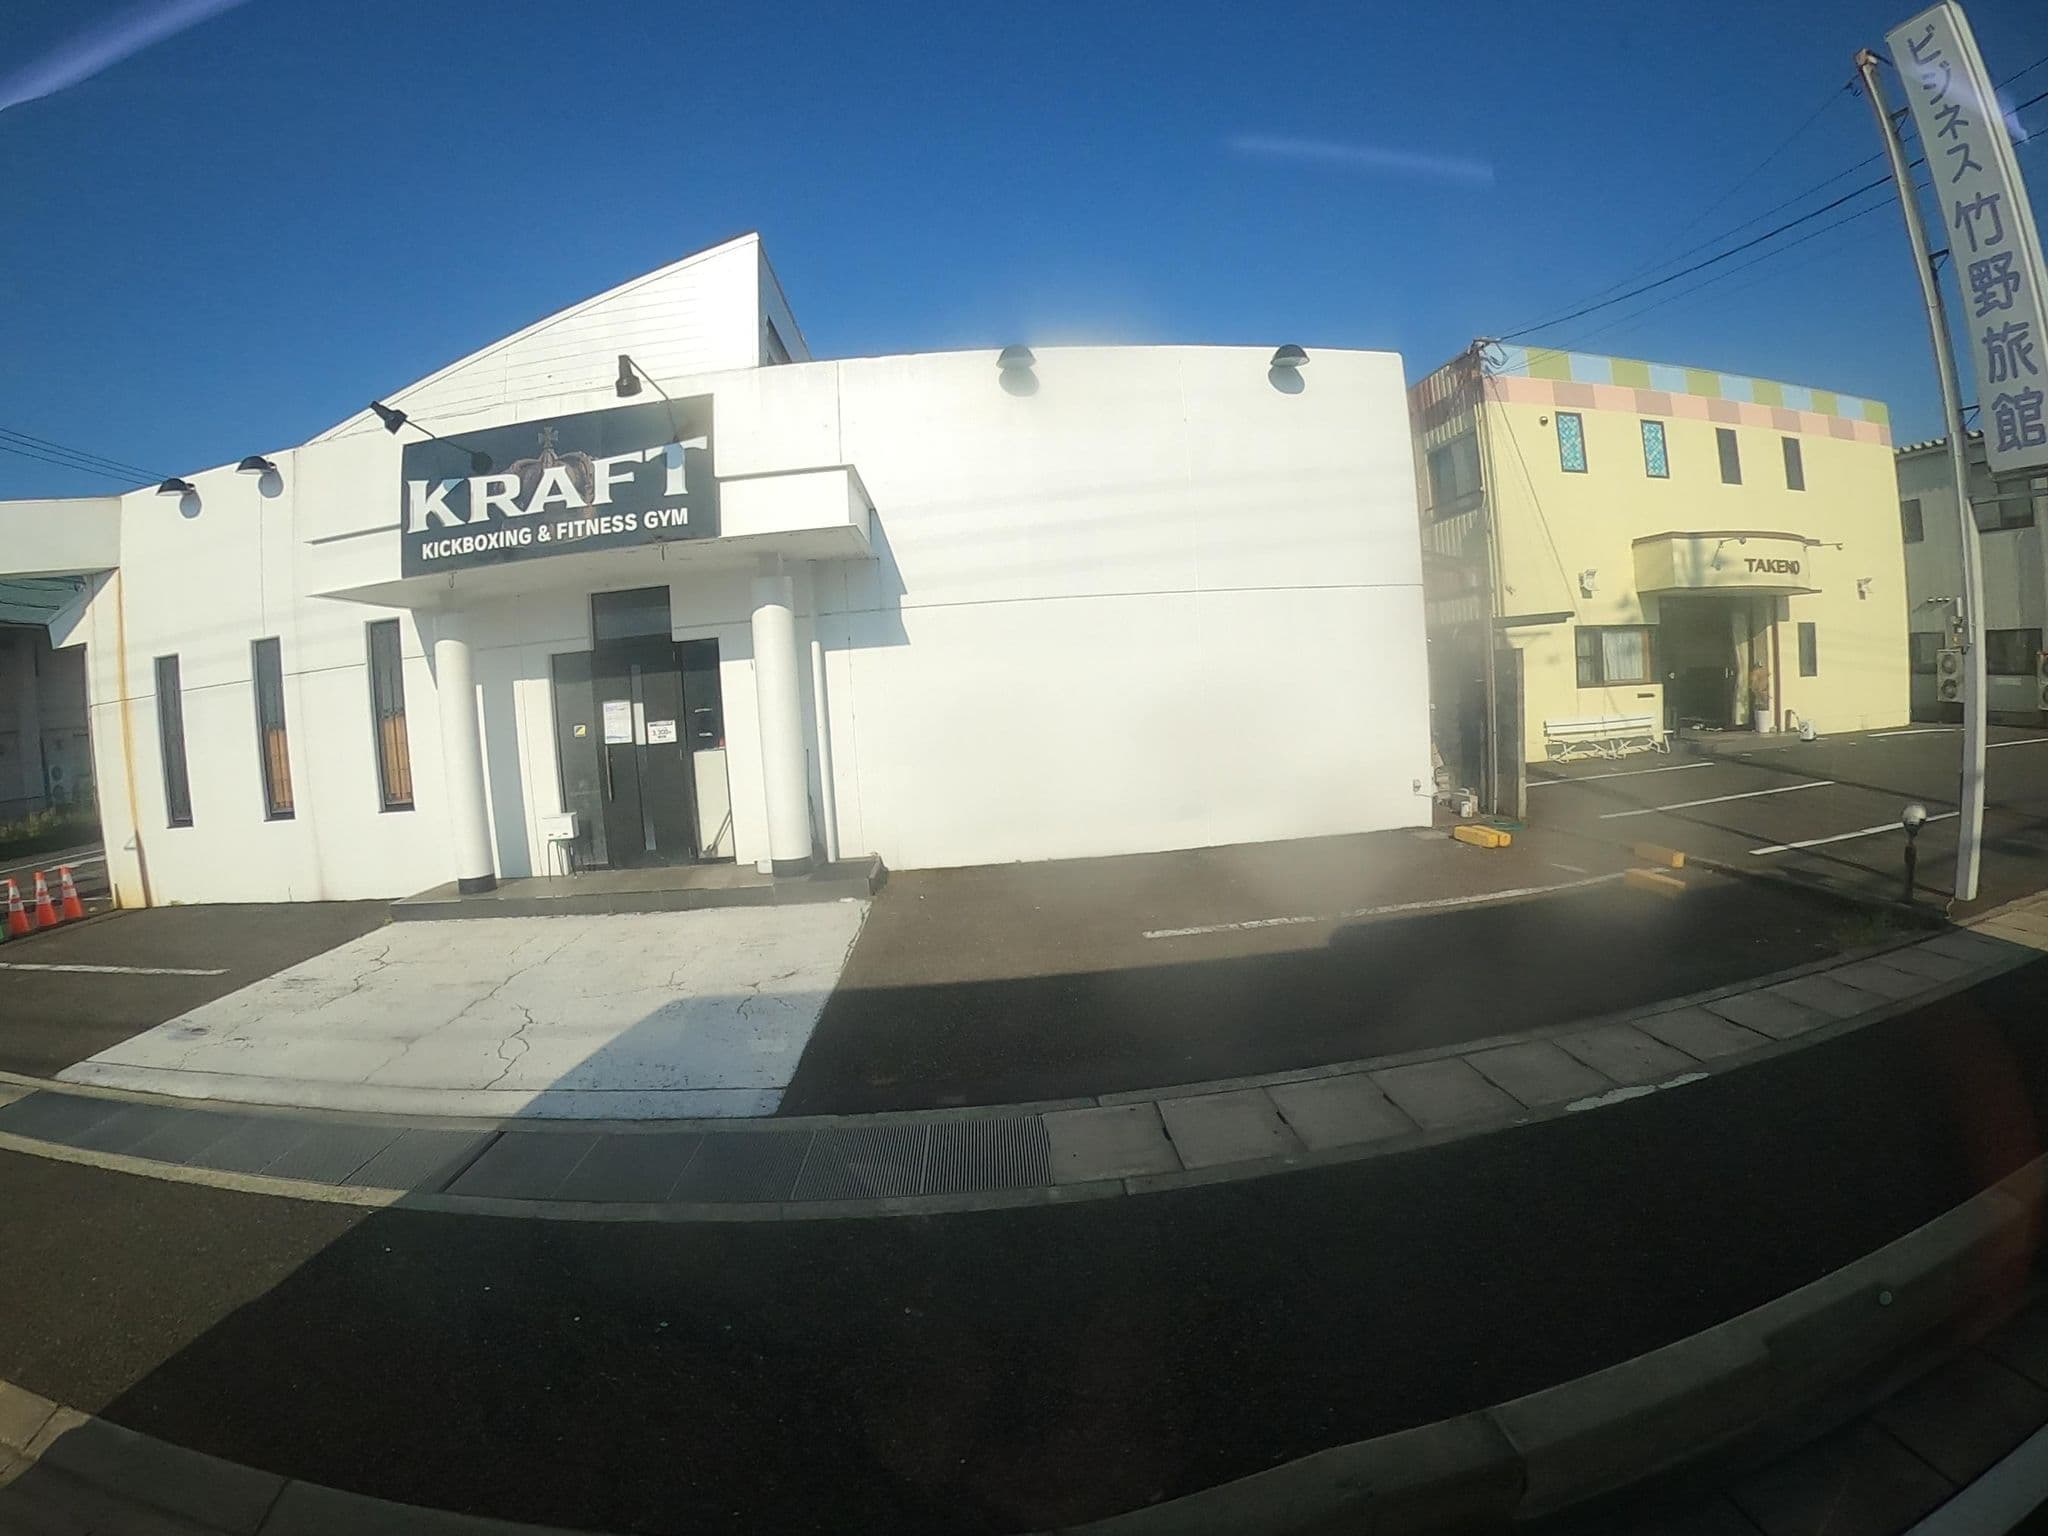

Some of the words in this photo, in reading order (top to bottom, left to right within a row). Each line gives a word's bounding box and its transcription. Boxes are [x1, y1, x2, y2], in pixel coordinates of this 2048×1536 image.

[407, 436, 708, 534] KRAFT
[421, 527, 532, 560] KICKBOXING
[537, 525, 552, 542] &
[557, 513, 638, 540] FITNESS
[643, 507, 689, 529] GYM
[1743, 558, 1800, 575] TAKENO
